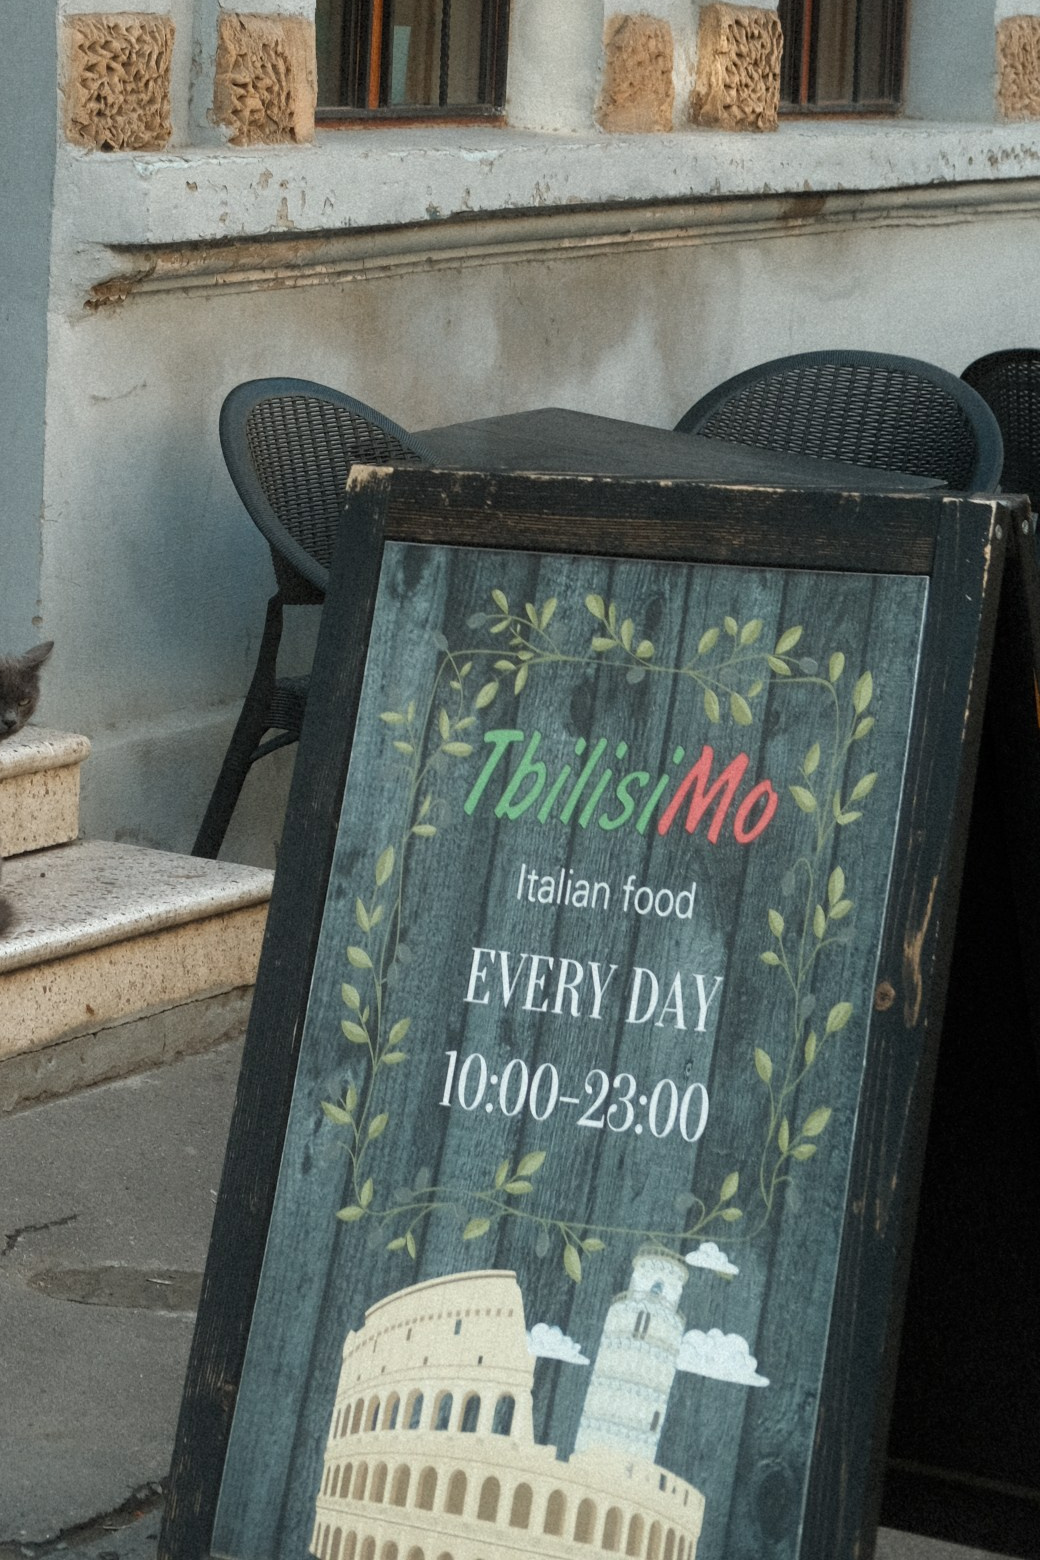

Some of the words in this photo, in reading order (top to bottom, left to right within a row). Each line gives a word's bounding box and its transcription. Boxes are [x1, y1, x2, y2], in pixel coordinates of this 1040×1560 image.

[464, 730, 779, 845] TbilisiMo
[517, 864, 611, 911] Italian
[623, 875, 698, 920] food
[463, 947, 619, 1021] EVERY
[625, 967, 724, 1033] DAY
